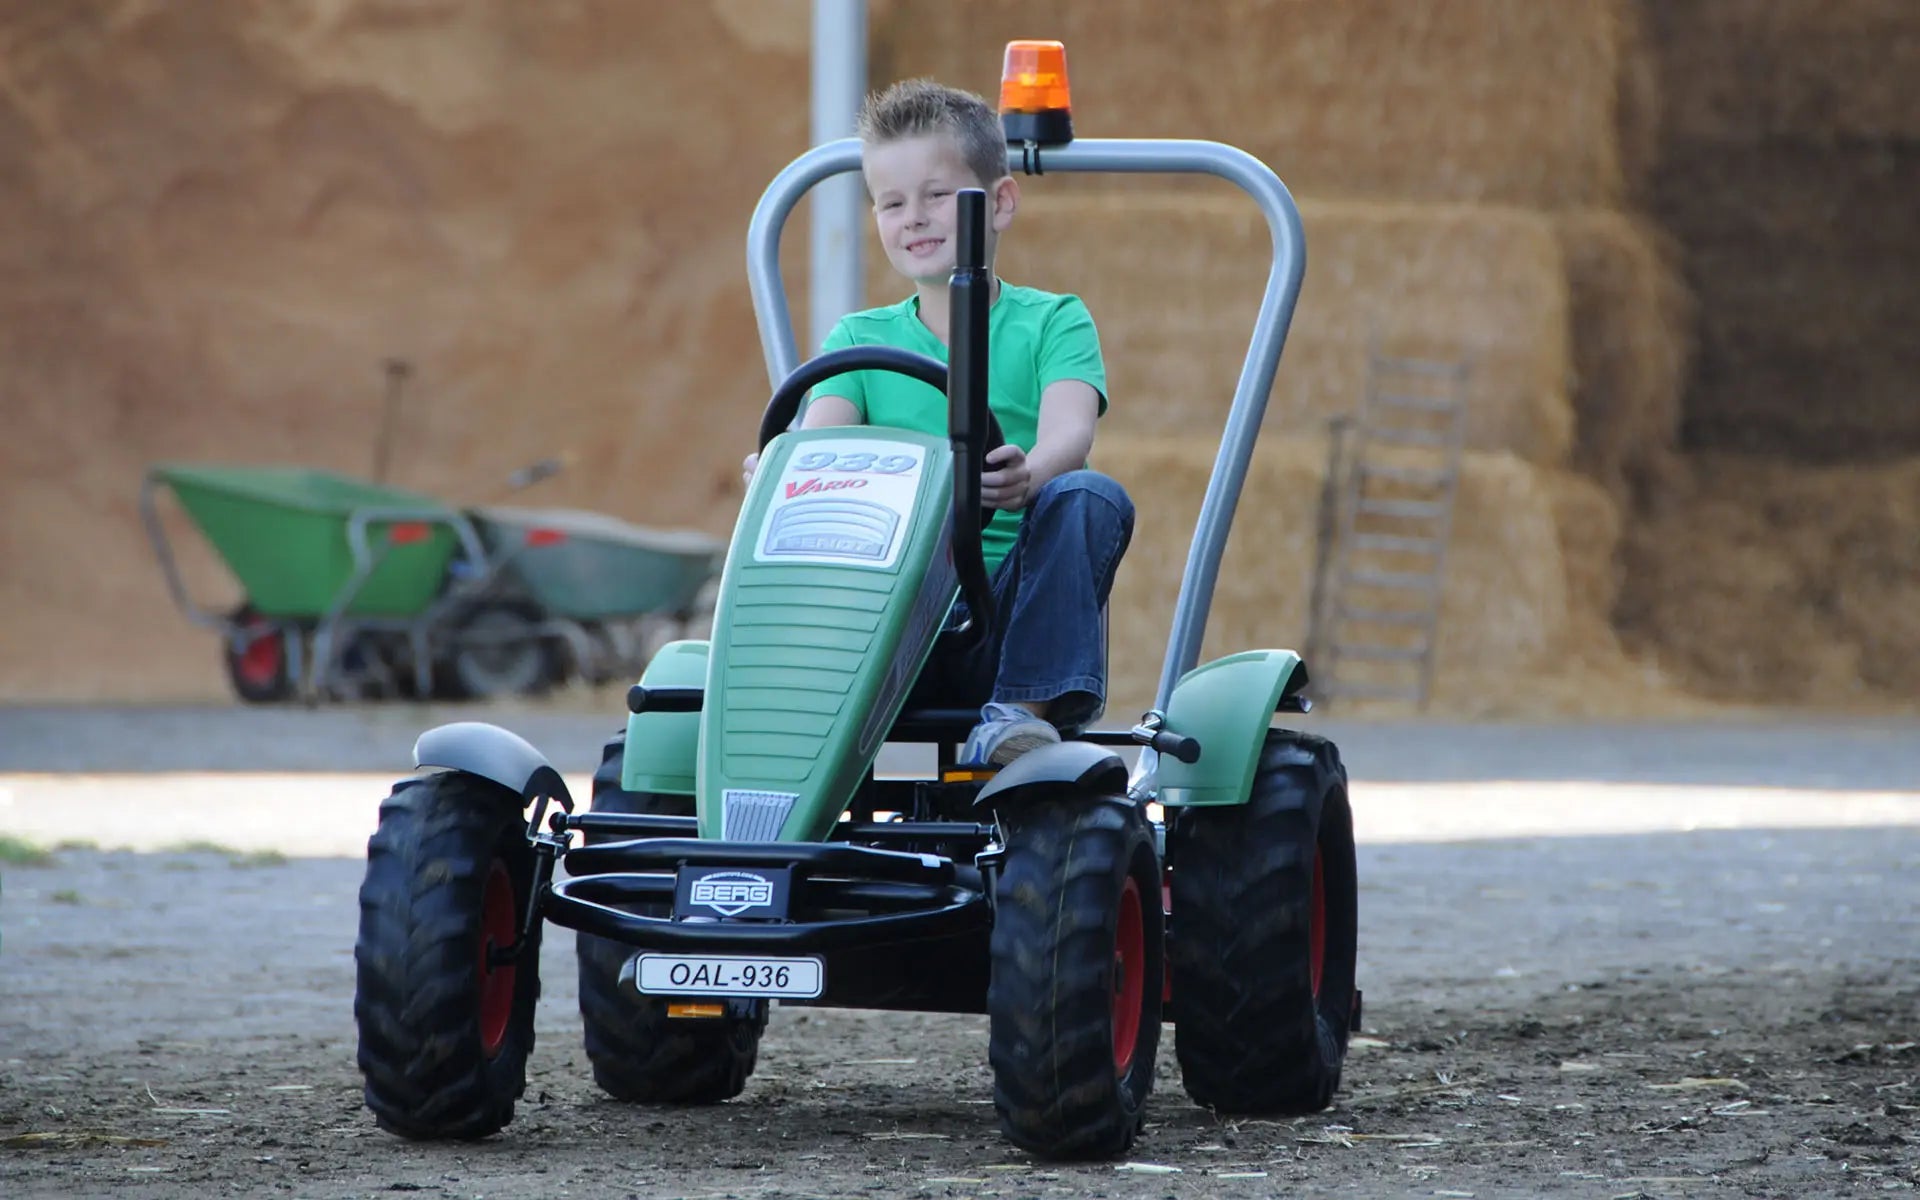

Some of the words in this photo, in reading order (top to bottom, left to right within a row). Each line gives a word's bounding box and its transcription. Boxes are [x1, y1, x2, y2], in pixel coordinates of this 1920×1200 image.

[793, 452, 918, 474] 939
[785, 477, 868, 499] VARIO
[695, 885, 768, 901] BERG
[669, 963, 790, 988] OAL-936
